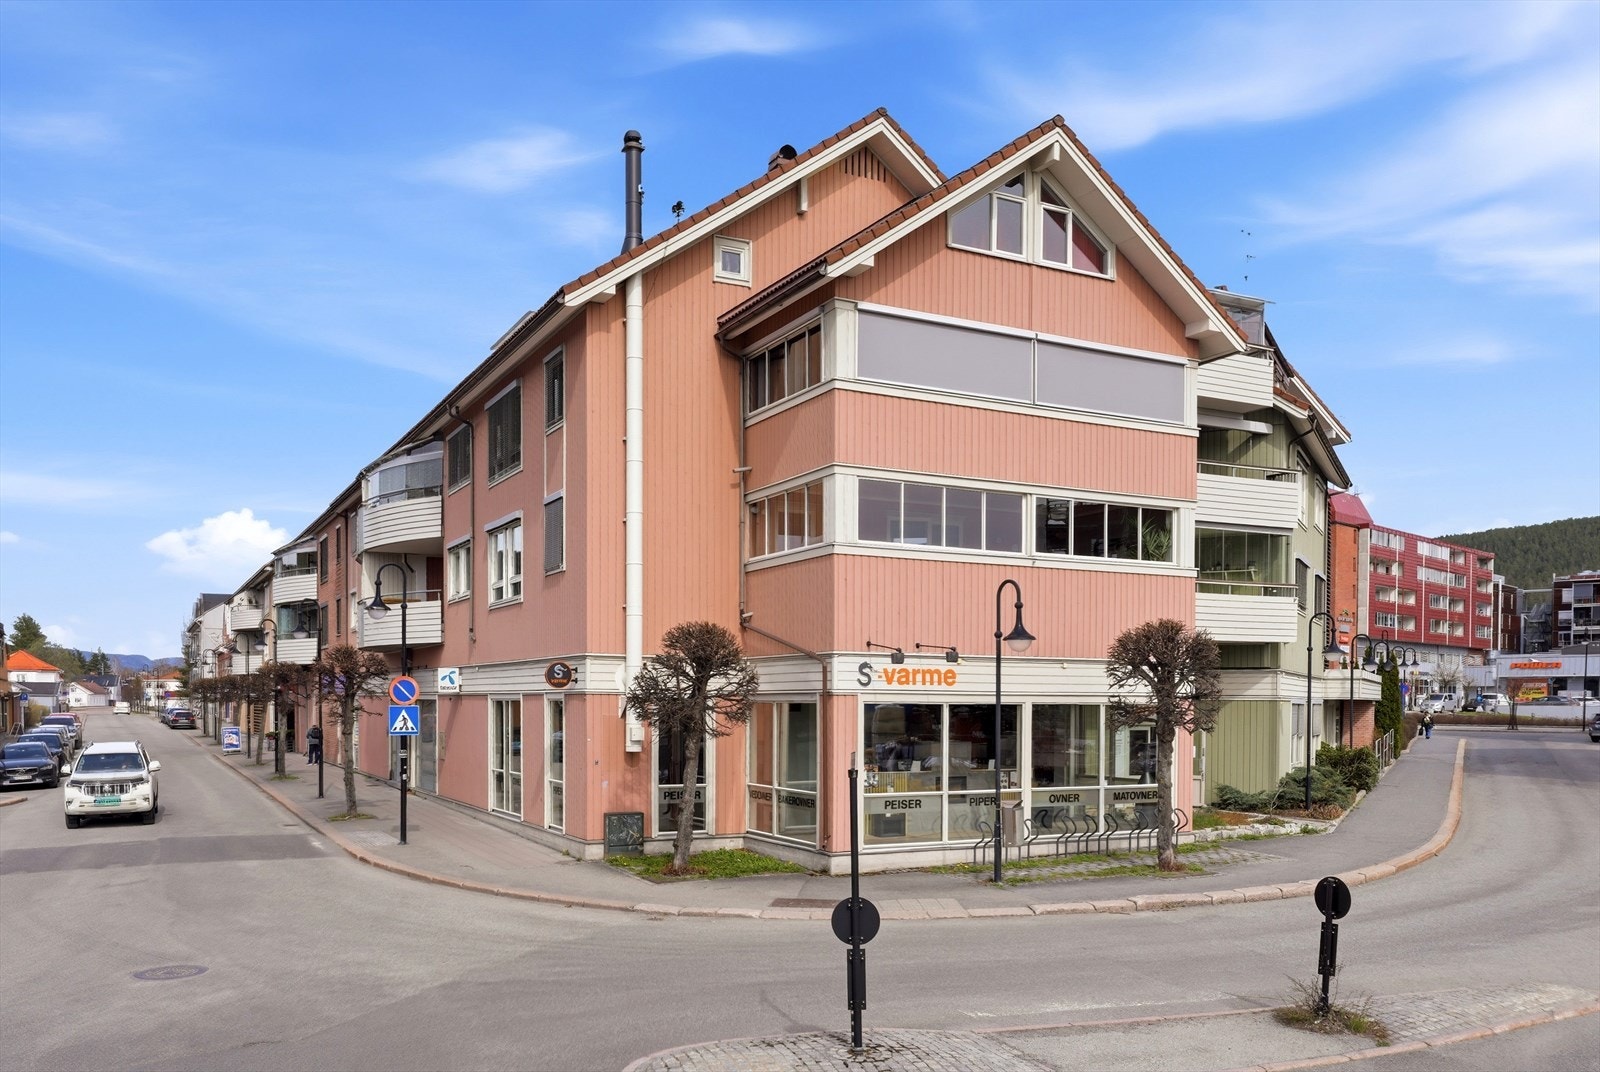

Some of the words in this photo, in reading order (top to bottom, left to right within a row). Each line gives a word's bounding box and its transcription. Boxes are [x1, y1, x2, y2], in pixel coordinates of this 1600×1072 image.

[1049, 793, 1080, 803] OVNER
[1113, 790, 1159, 801] MATOVNER
[884, 799, 922, 810] PEISER
[969, 796, 997, 807] PIPER
